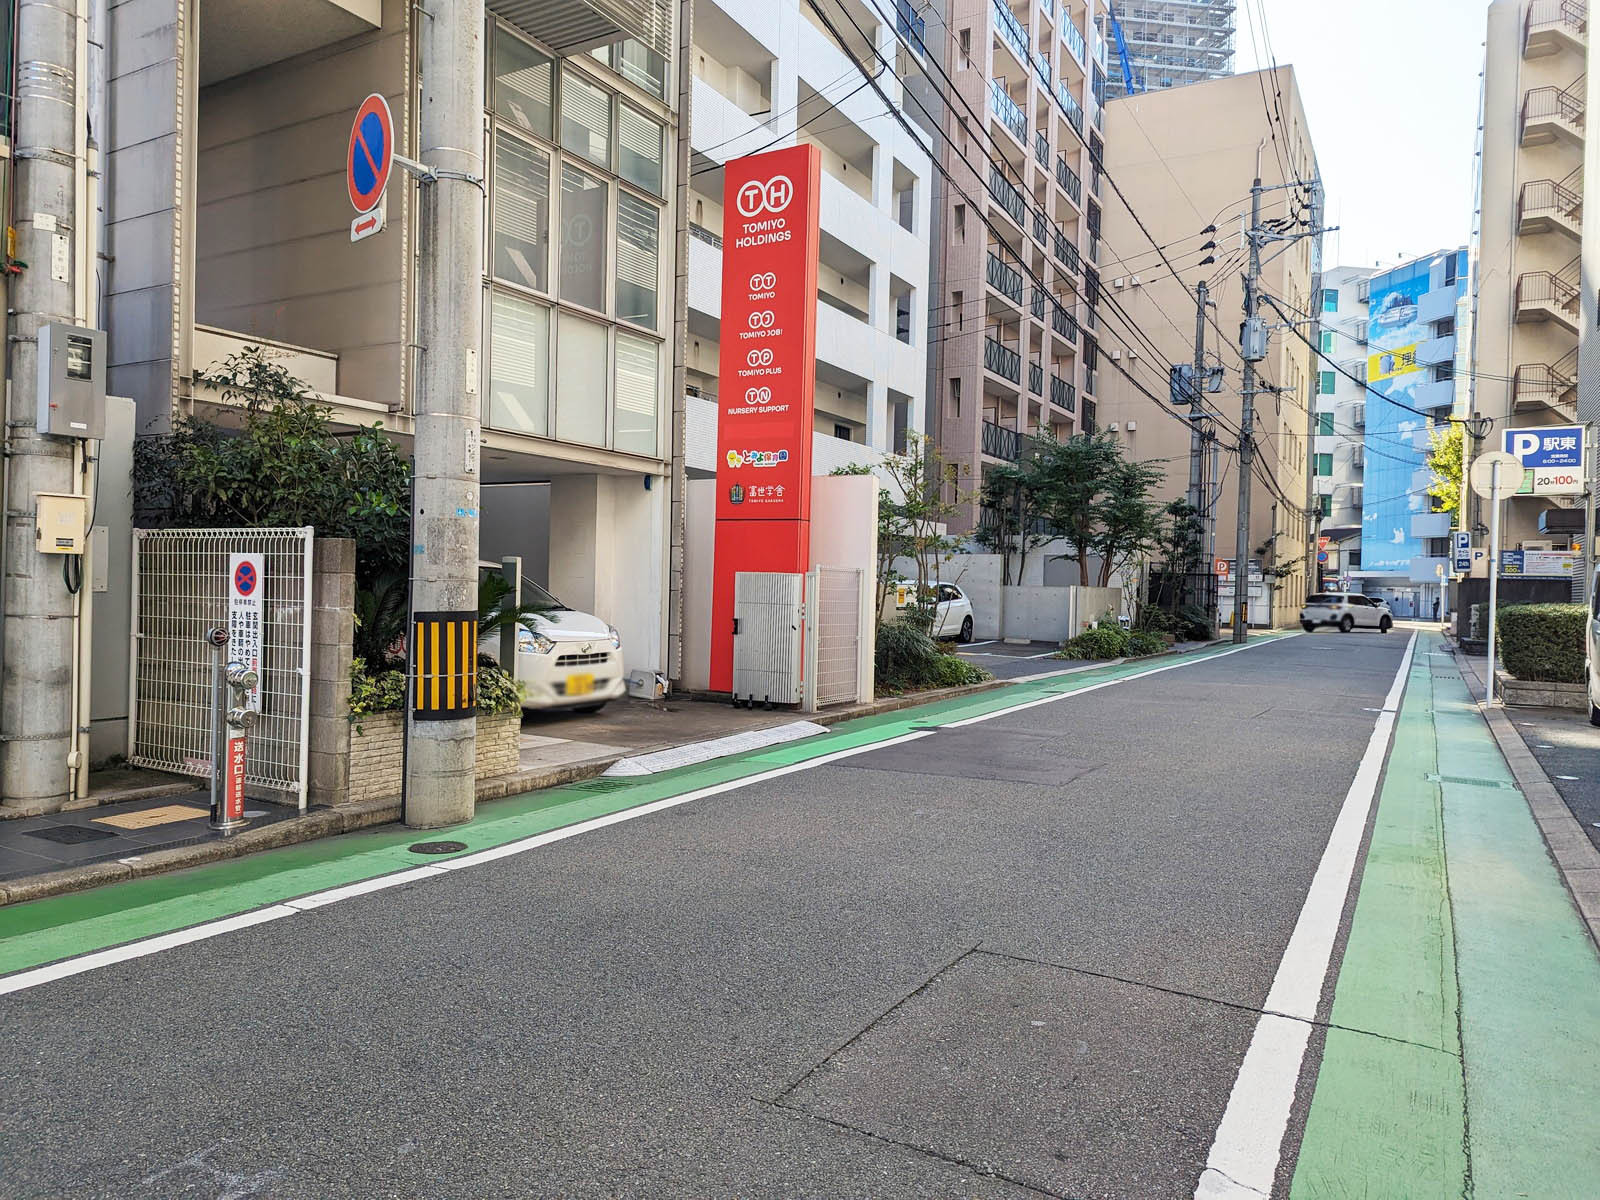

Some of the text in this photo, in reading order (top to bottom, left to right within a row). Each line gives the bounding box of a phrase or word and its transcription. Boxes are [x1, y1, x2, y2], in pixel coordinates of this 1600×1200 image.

[742, 181, 788, 212] TH
[742, 218, 786, 235] TOMIYO
[735, 230, 792, 249] HOLDINGS
[748, 291, 776, 301] TOMIYO
[739, 328, 783, 340] TOMIYO JOB!
[738, 367, 782, 377] TOMIYO PLUS
[728, 404, 789, 415] NURSERY SUPPORT
[1513, 433, 1540, 466] P
[1543, 437, 1577, 451] 駅東
[1459, 534, 1468, 548] P
[1474, 551, 1484, 560] P
[1217, 561, 1227, 571] P
